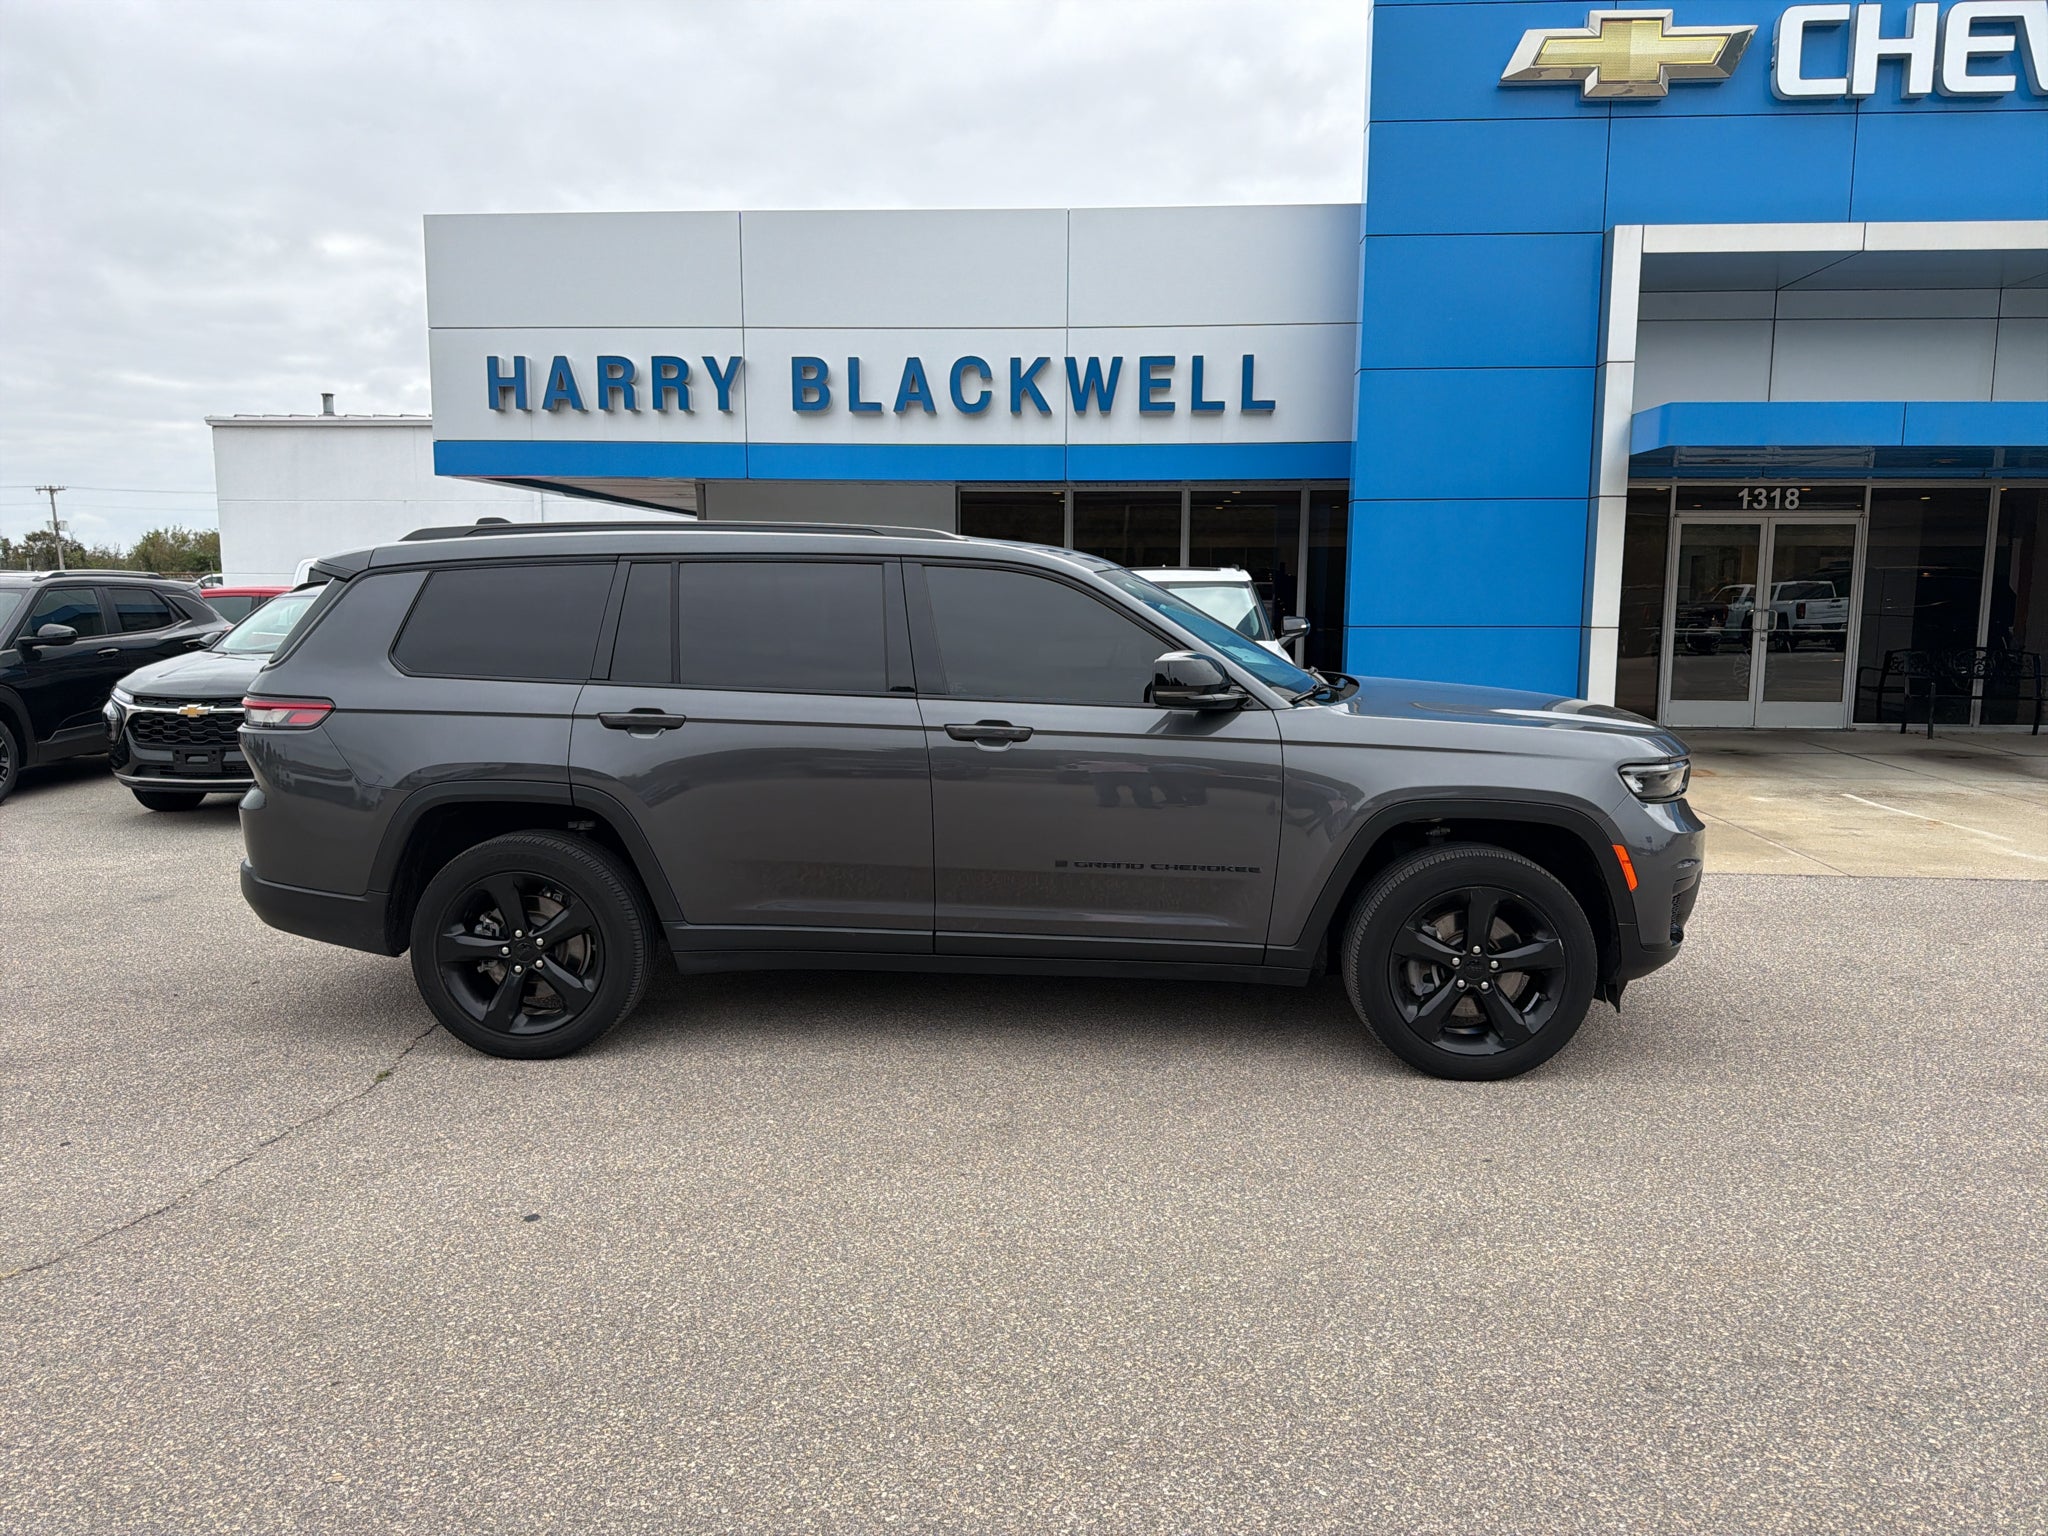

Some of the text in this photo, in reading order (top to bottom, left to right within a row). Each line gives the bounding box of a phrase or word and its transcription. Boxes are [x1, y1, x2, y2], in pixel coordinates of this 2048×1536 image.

[487, 354, 1276, 414] HARRY BLACKWELL
[1738, 488, 1799, 510] 1318
[1073, 860, 1262, 874] GRAND CHEROKEE
